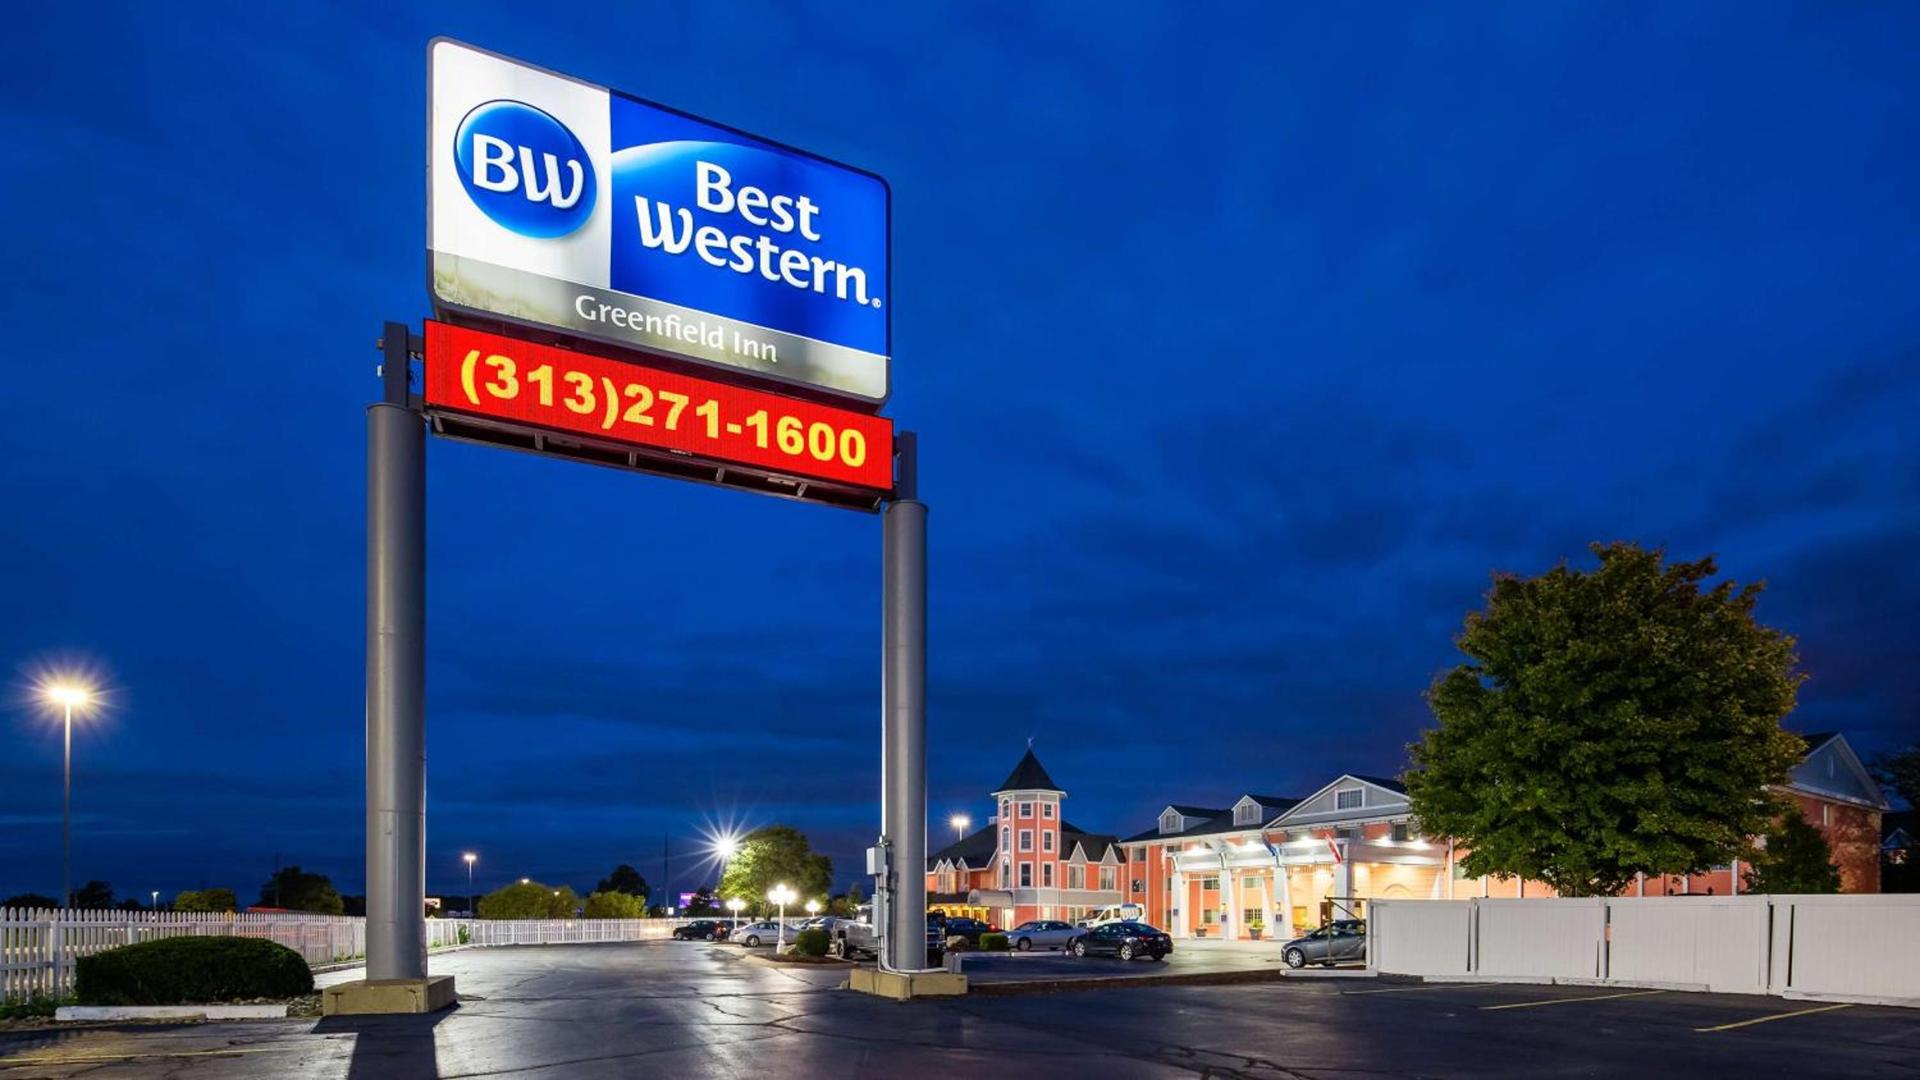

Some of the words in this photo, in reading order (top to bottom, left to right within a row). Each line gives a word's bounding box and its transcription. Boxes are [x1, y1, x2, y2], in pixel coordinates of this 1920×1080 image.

[472, 133, 583, 209] BW
[696, 160, 821, 241] Best
[635, 194, 871, 306] Western
[575, 295, 725, 350] Greenfield
[733, 331, 778, 362] Inn
[460, 349, 867, 468] (313)271-1600
